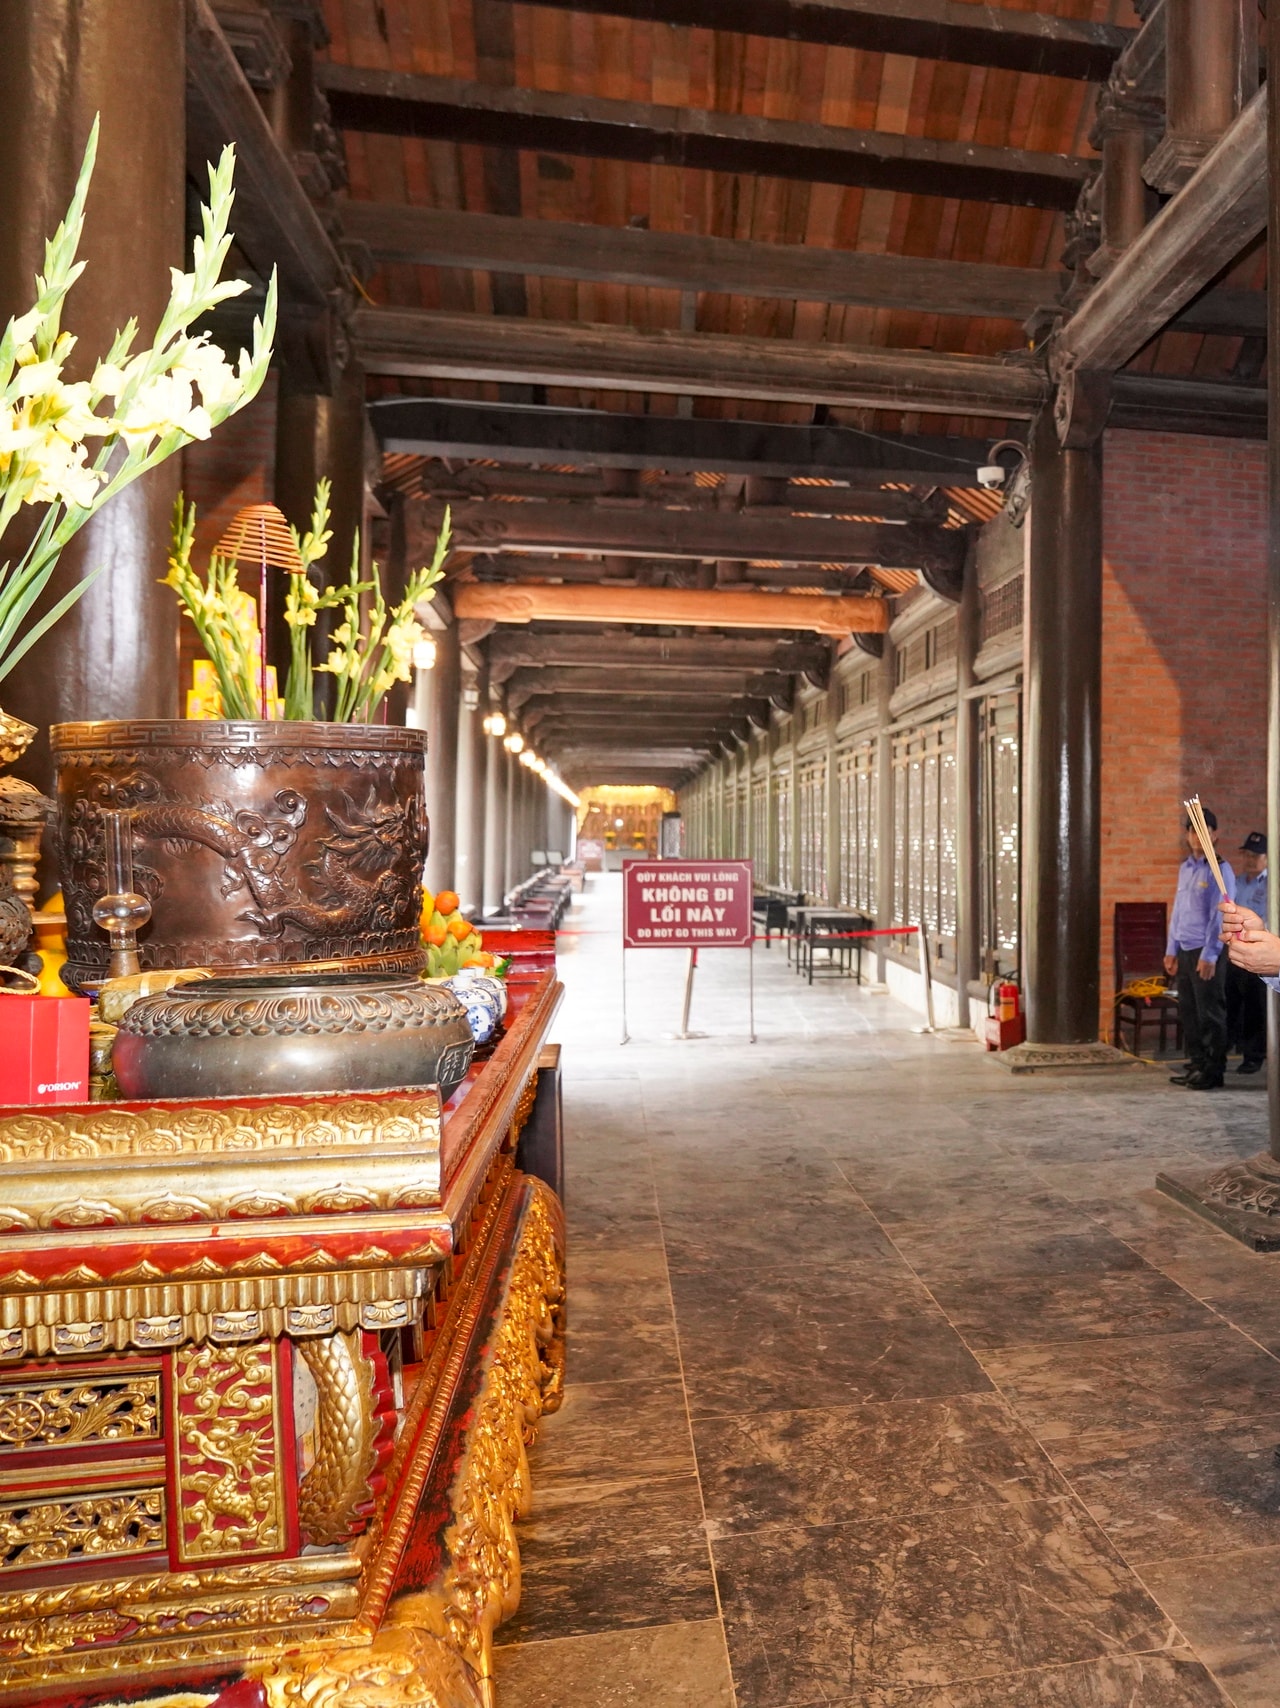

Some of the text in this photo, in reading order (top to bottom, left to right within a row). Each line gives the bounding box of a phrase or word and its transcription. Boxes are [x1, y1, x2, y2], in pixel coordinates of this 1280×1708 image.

[658, 871, 693, 882] KHÁCH
[694, 873, 711, 882] VUI
[712, 871, 739, 882] LÒNG
[642, 885, 734, 902] KHÔNG ĐI
[650, 903, 726, 922] LỐI NÀY
[637, 928, 738, 938] DO NOT GO THIS WAY
[47, 1082, 79, 1092] ORION
